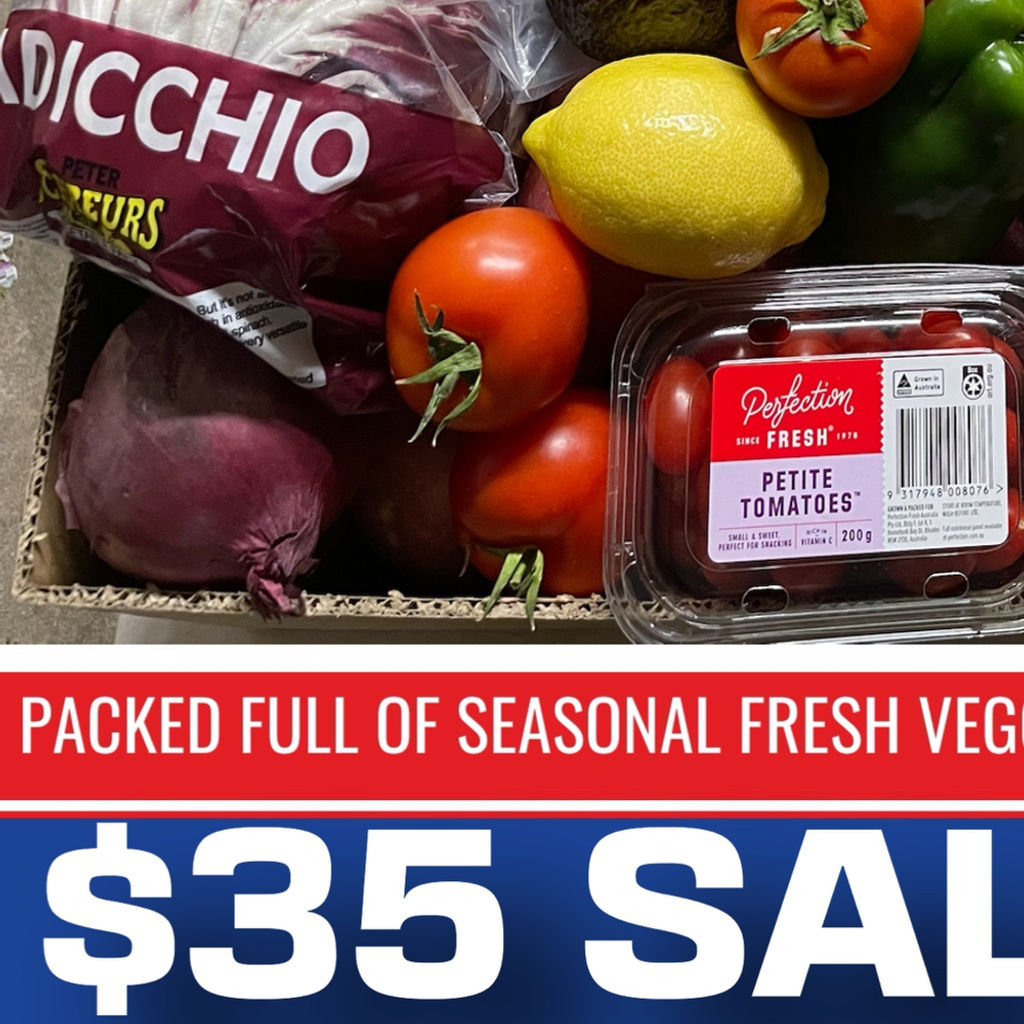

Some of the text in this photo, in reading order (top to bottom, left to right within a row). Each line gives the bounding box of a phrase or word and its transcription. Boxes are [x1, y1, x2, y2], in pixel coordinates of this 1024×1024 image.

[62, 156, 122, 189] PETER
[196, 303, 217, 316] But
[235, 290, 254, 303] not
[222, 313, 233, 325] in
[741, 373, 855, 428] Perfection
[736, 436, 760, 446] SINCE
[762, 468, 833, 492] PETITE
[718, 539, 792, 551] PERFECT FOR SNACKING
